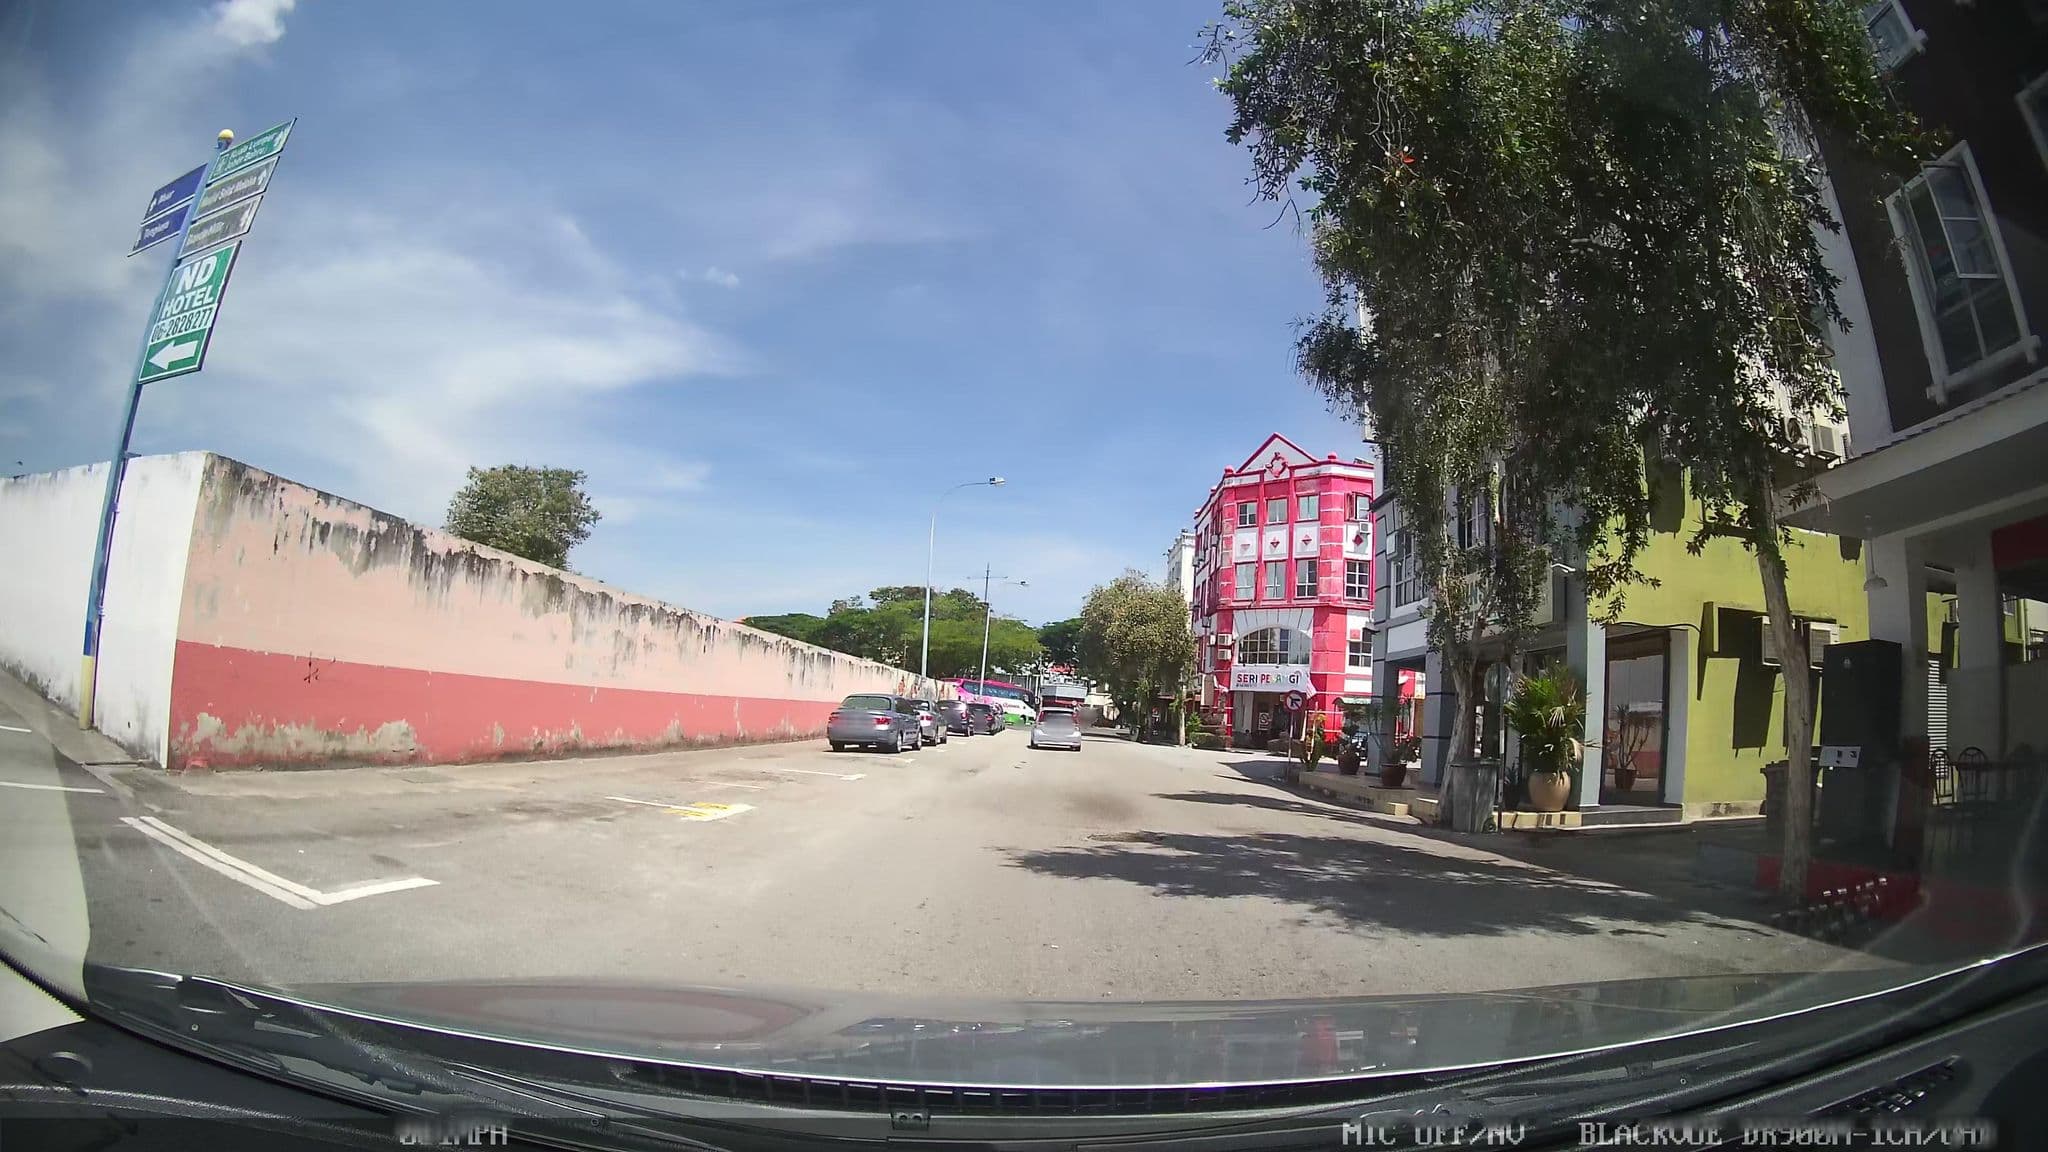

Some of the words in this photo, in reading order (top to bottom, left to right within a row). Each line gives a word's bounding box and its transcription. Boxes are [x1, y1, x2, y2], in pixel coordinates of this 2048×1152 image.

[175, 255, 218, 295] ND
[160, 285, 214, 319] HOTEL
[151, 307, 214, 343] 06-2828277
[1237, 673, 1258, 684] SERI
